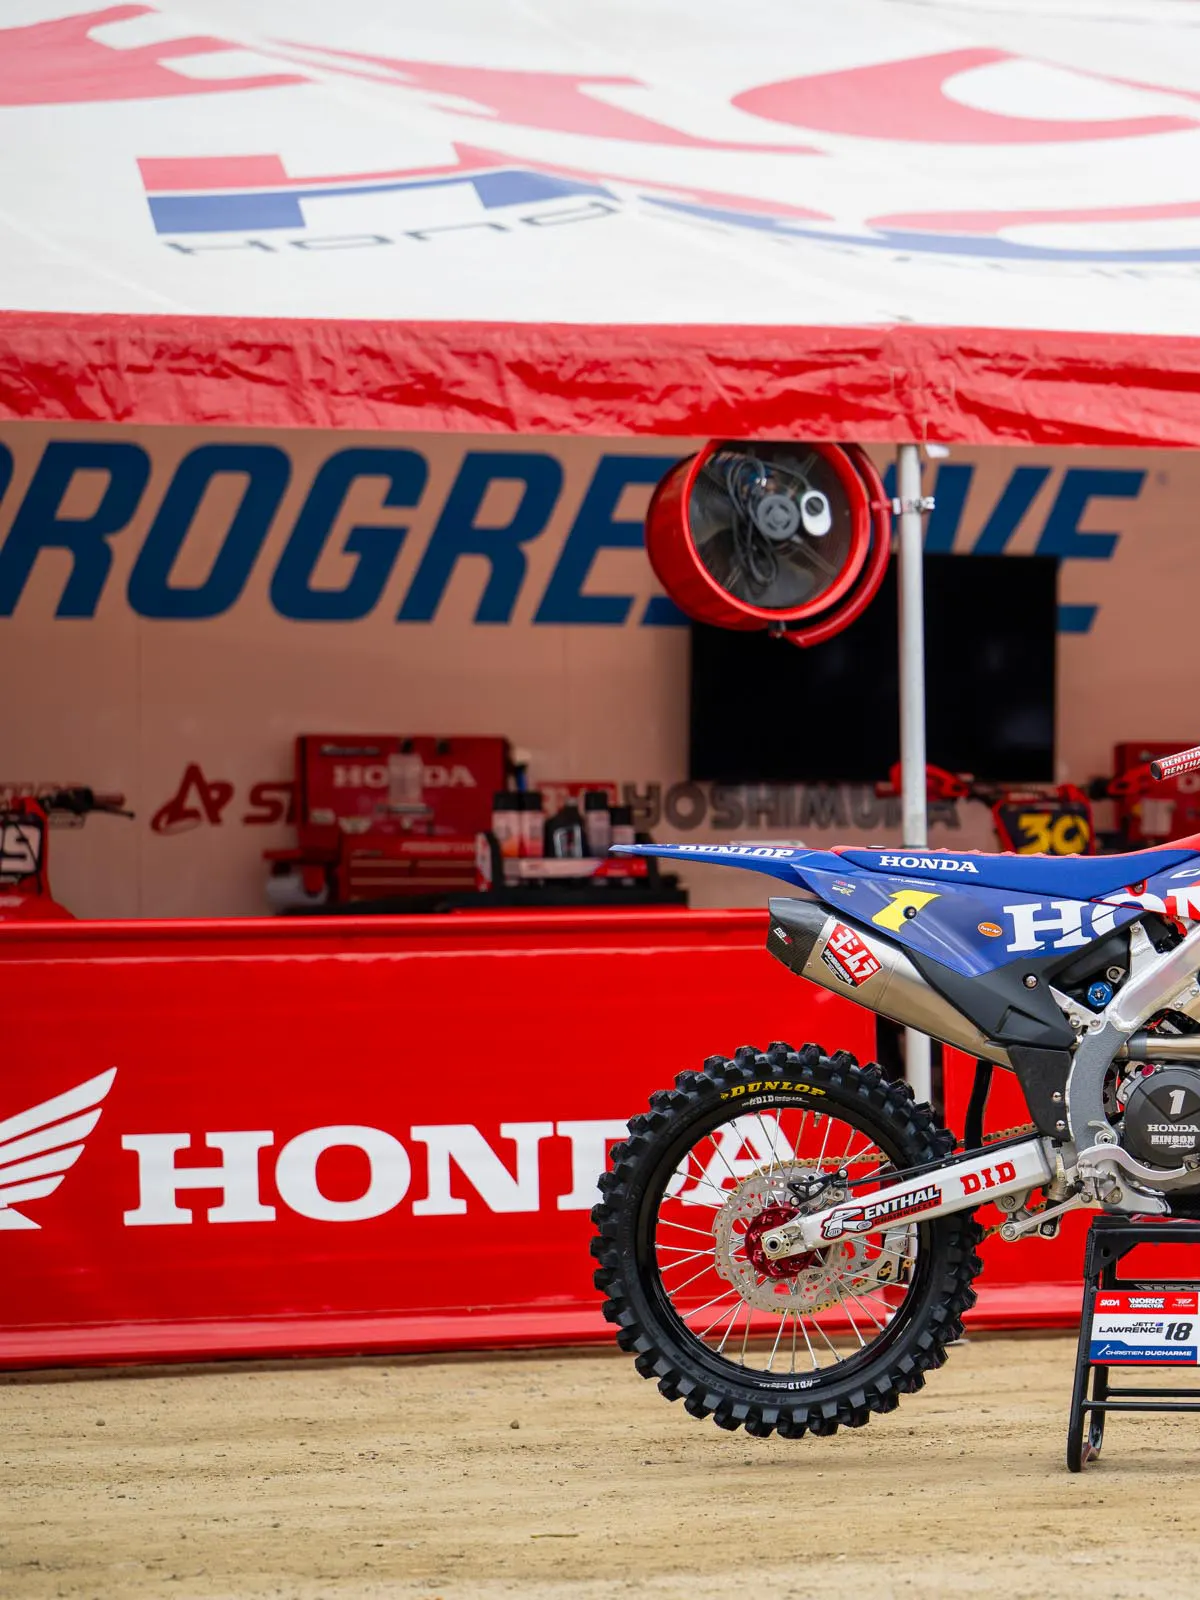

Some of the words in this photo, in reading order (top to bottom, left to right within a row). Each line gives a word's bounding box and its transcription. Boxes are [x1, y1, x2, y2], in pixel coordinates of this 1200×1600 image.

[333, 764, 477, 788] HODA
[678, 844, 796, 859] DUNLOP
[879, 855, 979, 873] HONDA
[872, 889, 942, 933] 1
[731, 1080, 827, 1099] DUNLOP
[1169, 1089, 1185, 1115] 1
[1147, 1124, 1200, 1133] HONDA
[1099, 1326, 1163, 1334] LAWRENCE
[1165, 1322, 1193, 1341] 18
